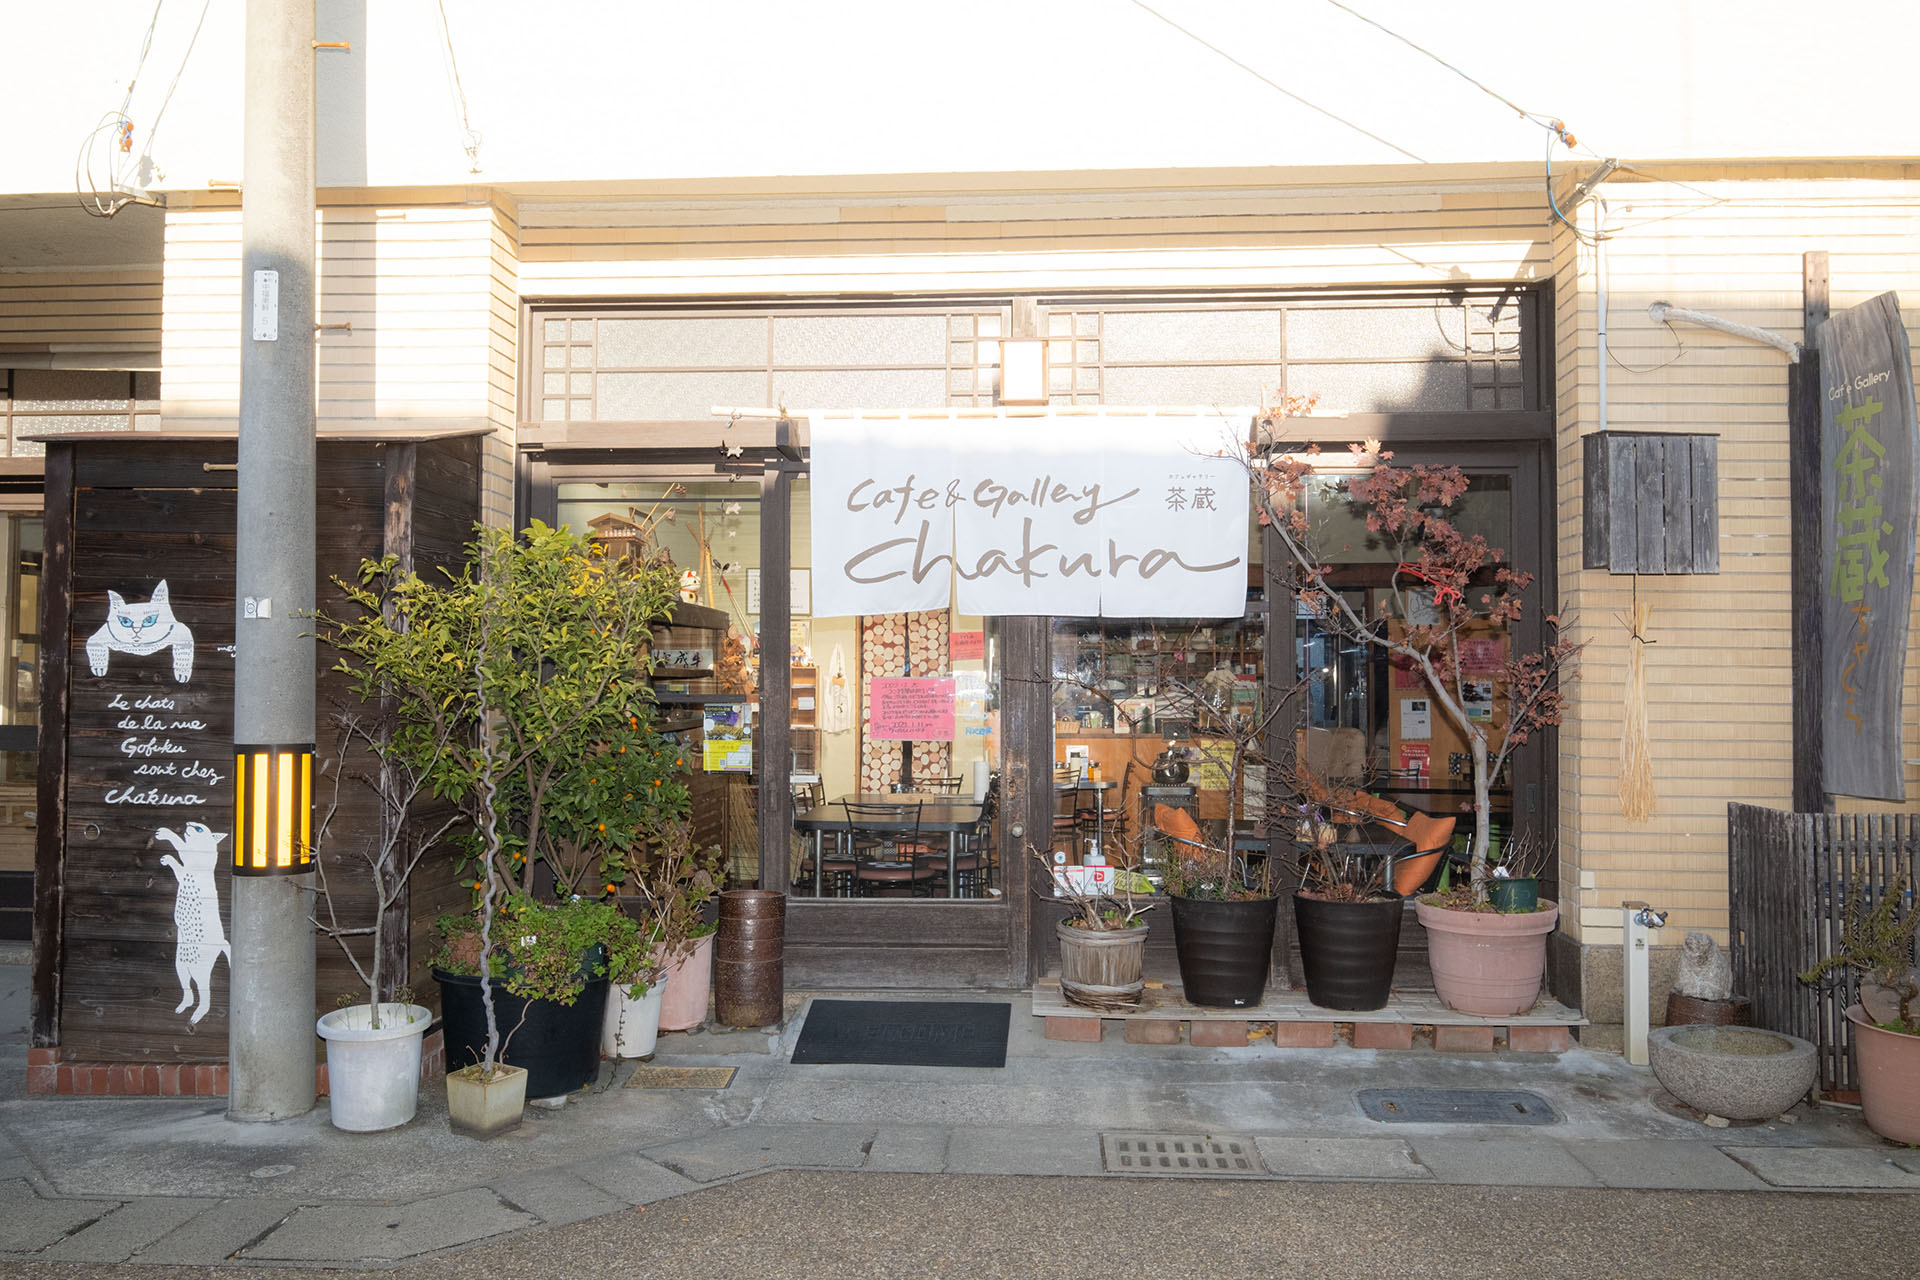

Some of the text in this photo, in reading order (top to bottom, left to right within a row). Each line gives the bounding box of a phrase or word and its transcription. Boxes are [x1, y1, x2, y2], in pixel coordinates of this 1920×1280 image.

[1854, 370, 1891, 390] Gallery
[1164, 485, 1218, 513] 茶蔵
[1830, 396, 1894, 603] 茶蔵
[1841, 600, 1873, 736] ちゃくら
[134, 694, 175, 711] chats
[117, 714, 139, 730] de
[141, 714, 167, 731] la
[133, 760, 226, 786] sont chez
